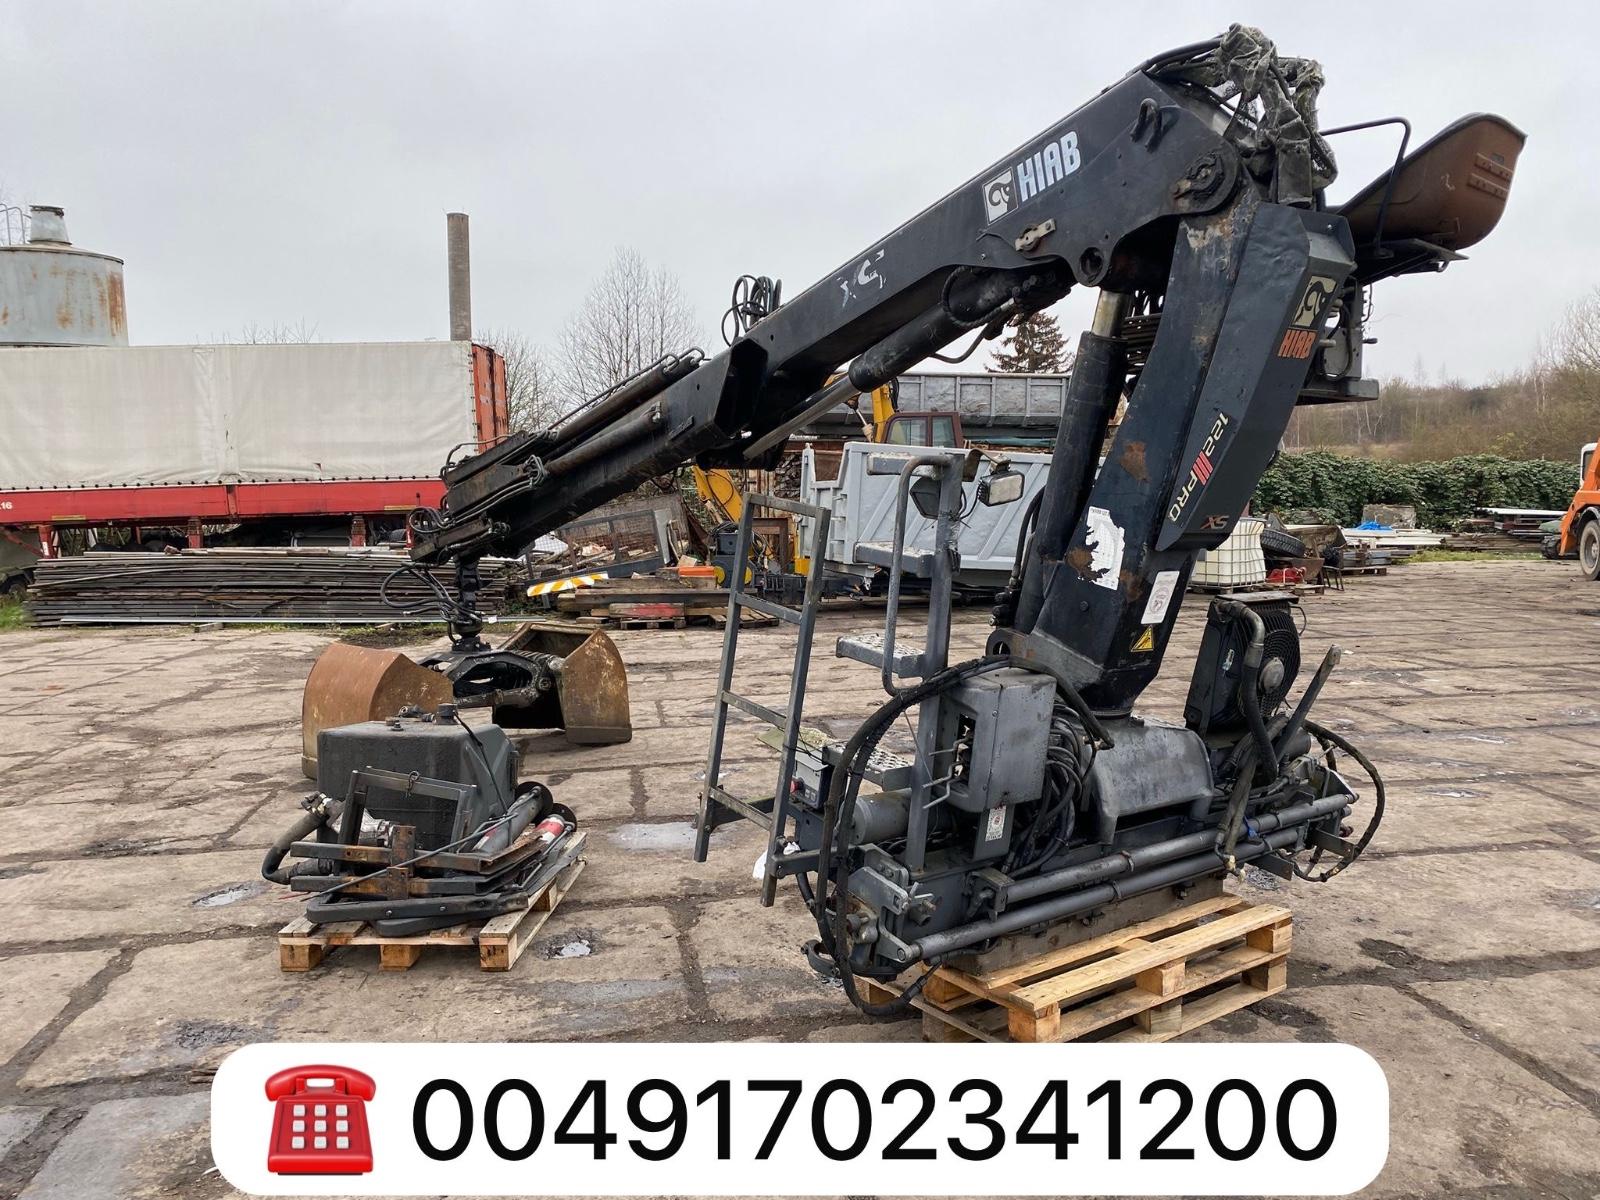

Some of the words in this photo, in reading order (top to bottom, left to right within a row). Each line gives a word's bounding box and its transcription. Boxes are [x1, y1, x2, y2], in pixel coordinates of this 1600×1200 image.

[1016, 130, 1082, 203] HIAB
[1277, 329, 1317, 359] HIAB
[1202, 412, 1229, 457] 122
[1168, 470, 1198, 522] PRO
[1200, 515, 1230, 530] XS
